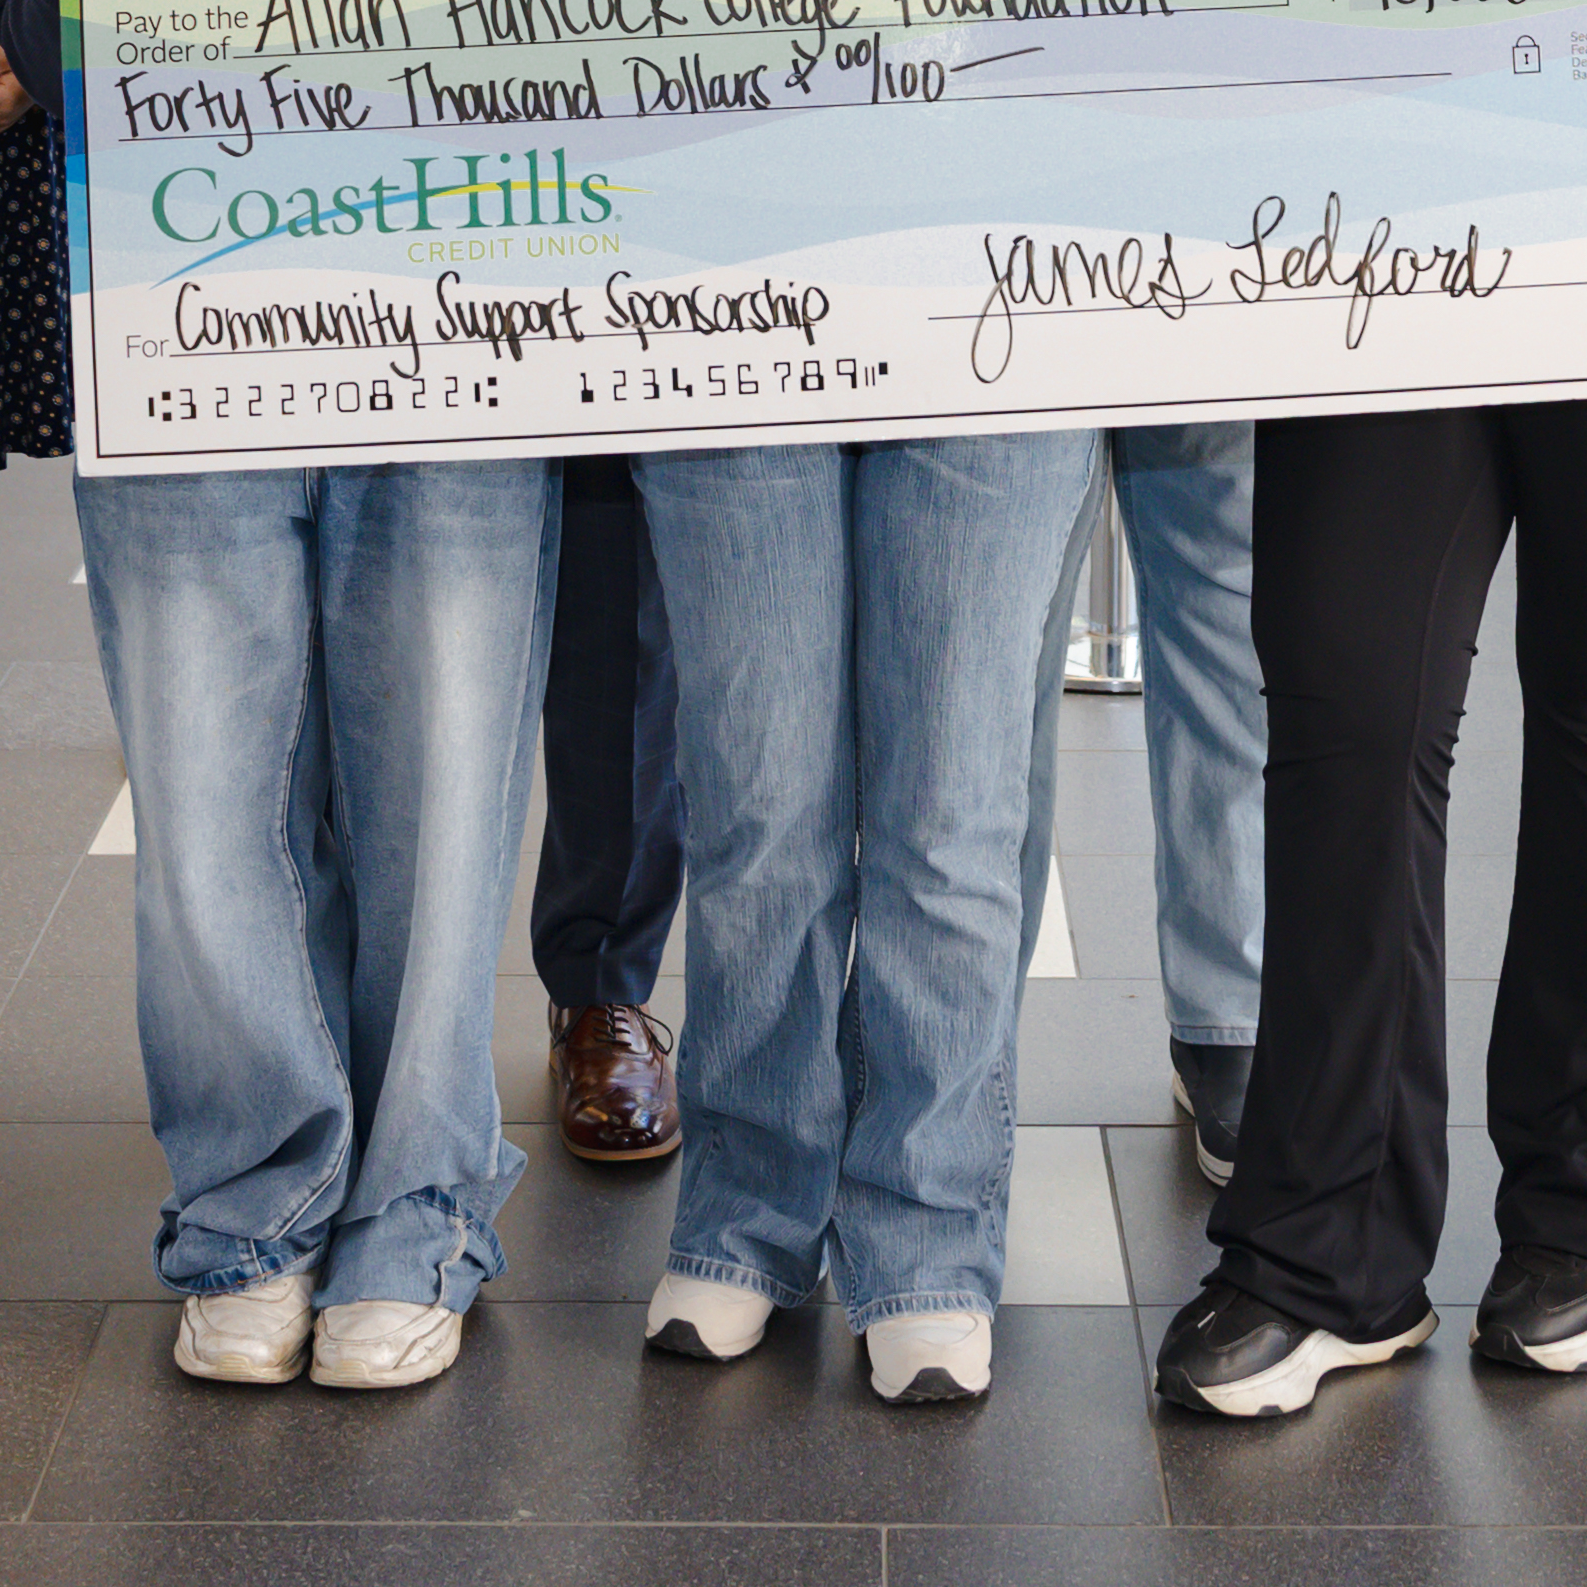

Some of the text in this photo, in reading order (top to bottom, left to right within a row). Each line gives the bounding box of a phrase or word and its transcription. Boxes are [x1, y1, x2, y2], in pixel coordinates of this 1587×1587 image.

[115, 5, 249, 39] Pay to the
[116, 36, 232, 65] Order of
[114, 70, 254, 157] Forty
[260, 64, 372, 130] Five
[387, 59, 603, 127] Thousand
[623, 54, 771, 117] Dollars
[151, 147, 613, 244] CoastHills
[407, 233, 621, 263] CREDIT UNION
[1226, 191, 1512, 351] Ledford
[126, 334, 170, 359] For
[174, 270, 830, 379] Community Support Sponsorship
